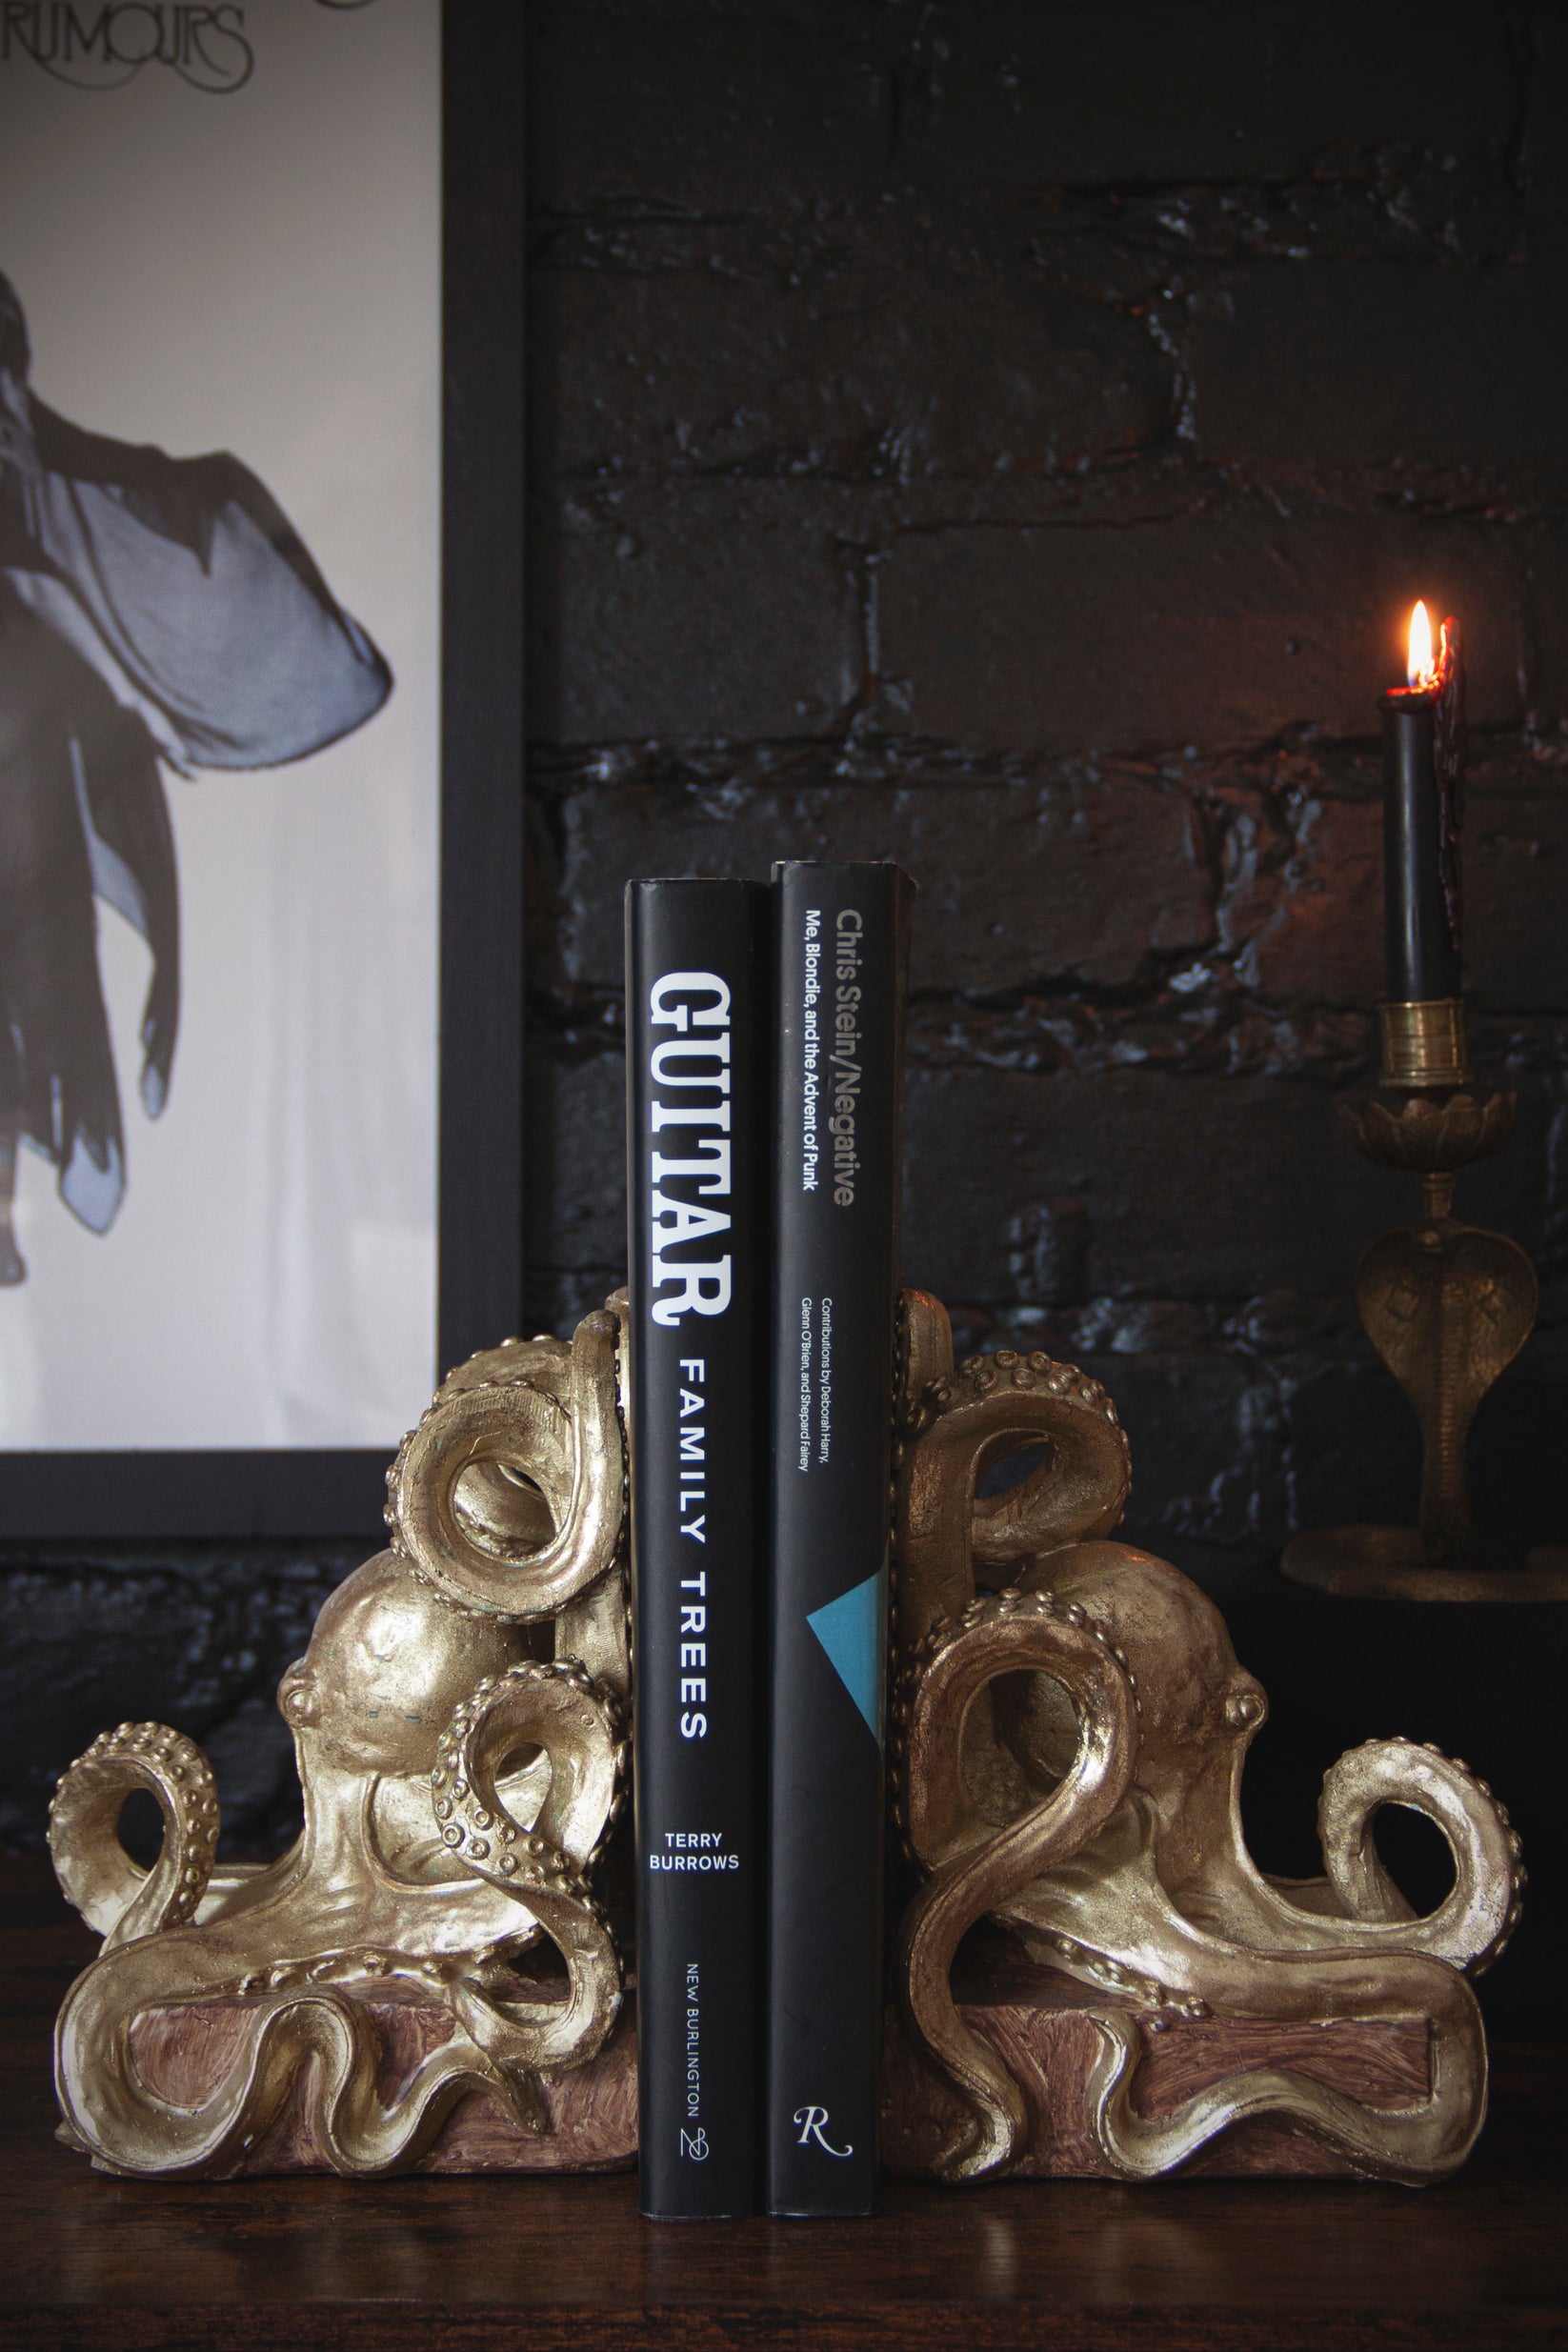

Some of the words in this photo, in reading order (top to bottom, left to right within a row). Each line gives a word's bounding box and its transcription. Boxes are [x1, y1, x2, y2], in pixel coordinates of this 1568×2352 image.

[0, 1, 255, 94] RUMOURS
[803, 910, 821, 940] Me,
[835, 908, 863, 980] Chris
[803, 943, 821, 1007] Blondie,
[804, 1009, 820, 1042] and
[804, 1043, 820, 1070] the
[803, 1072, 820, 1131] Advent
[828, 985, 862, 1206] Stein/Negative
[651, 972, 731, 1326] GUITAR
[803, 1132, 819, 1150] of
[802, 1151, 819, 1191] Punk
[801, 1297, 813, 1329] Glenn
[821, 1297, 833, 1369] Contributions
[800, 1373, 811, 1393] and
[819, 1370, 832, 1384] by
[798, 1394, 811, 1439] Shepard
[820, 1386, 832, 1432] Deborah
[679, 1358, 706, 1543] FAMILY
[798, 1440, 811, 1472] Fairey
[818, 1434, 831, 1463] Harry,
[680, 1571, 707, 1739] TREES
[665, 1832, 722, 1848] TERRY
[650, 1854, 739, 1871] BURROWS
[687, 1963, 699, 2001] NEW
[687, 2008, 699, 2117] BURLINGTON
